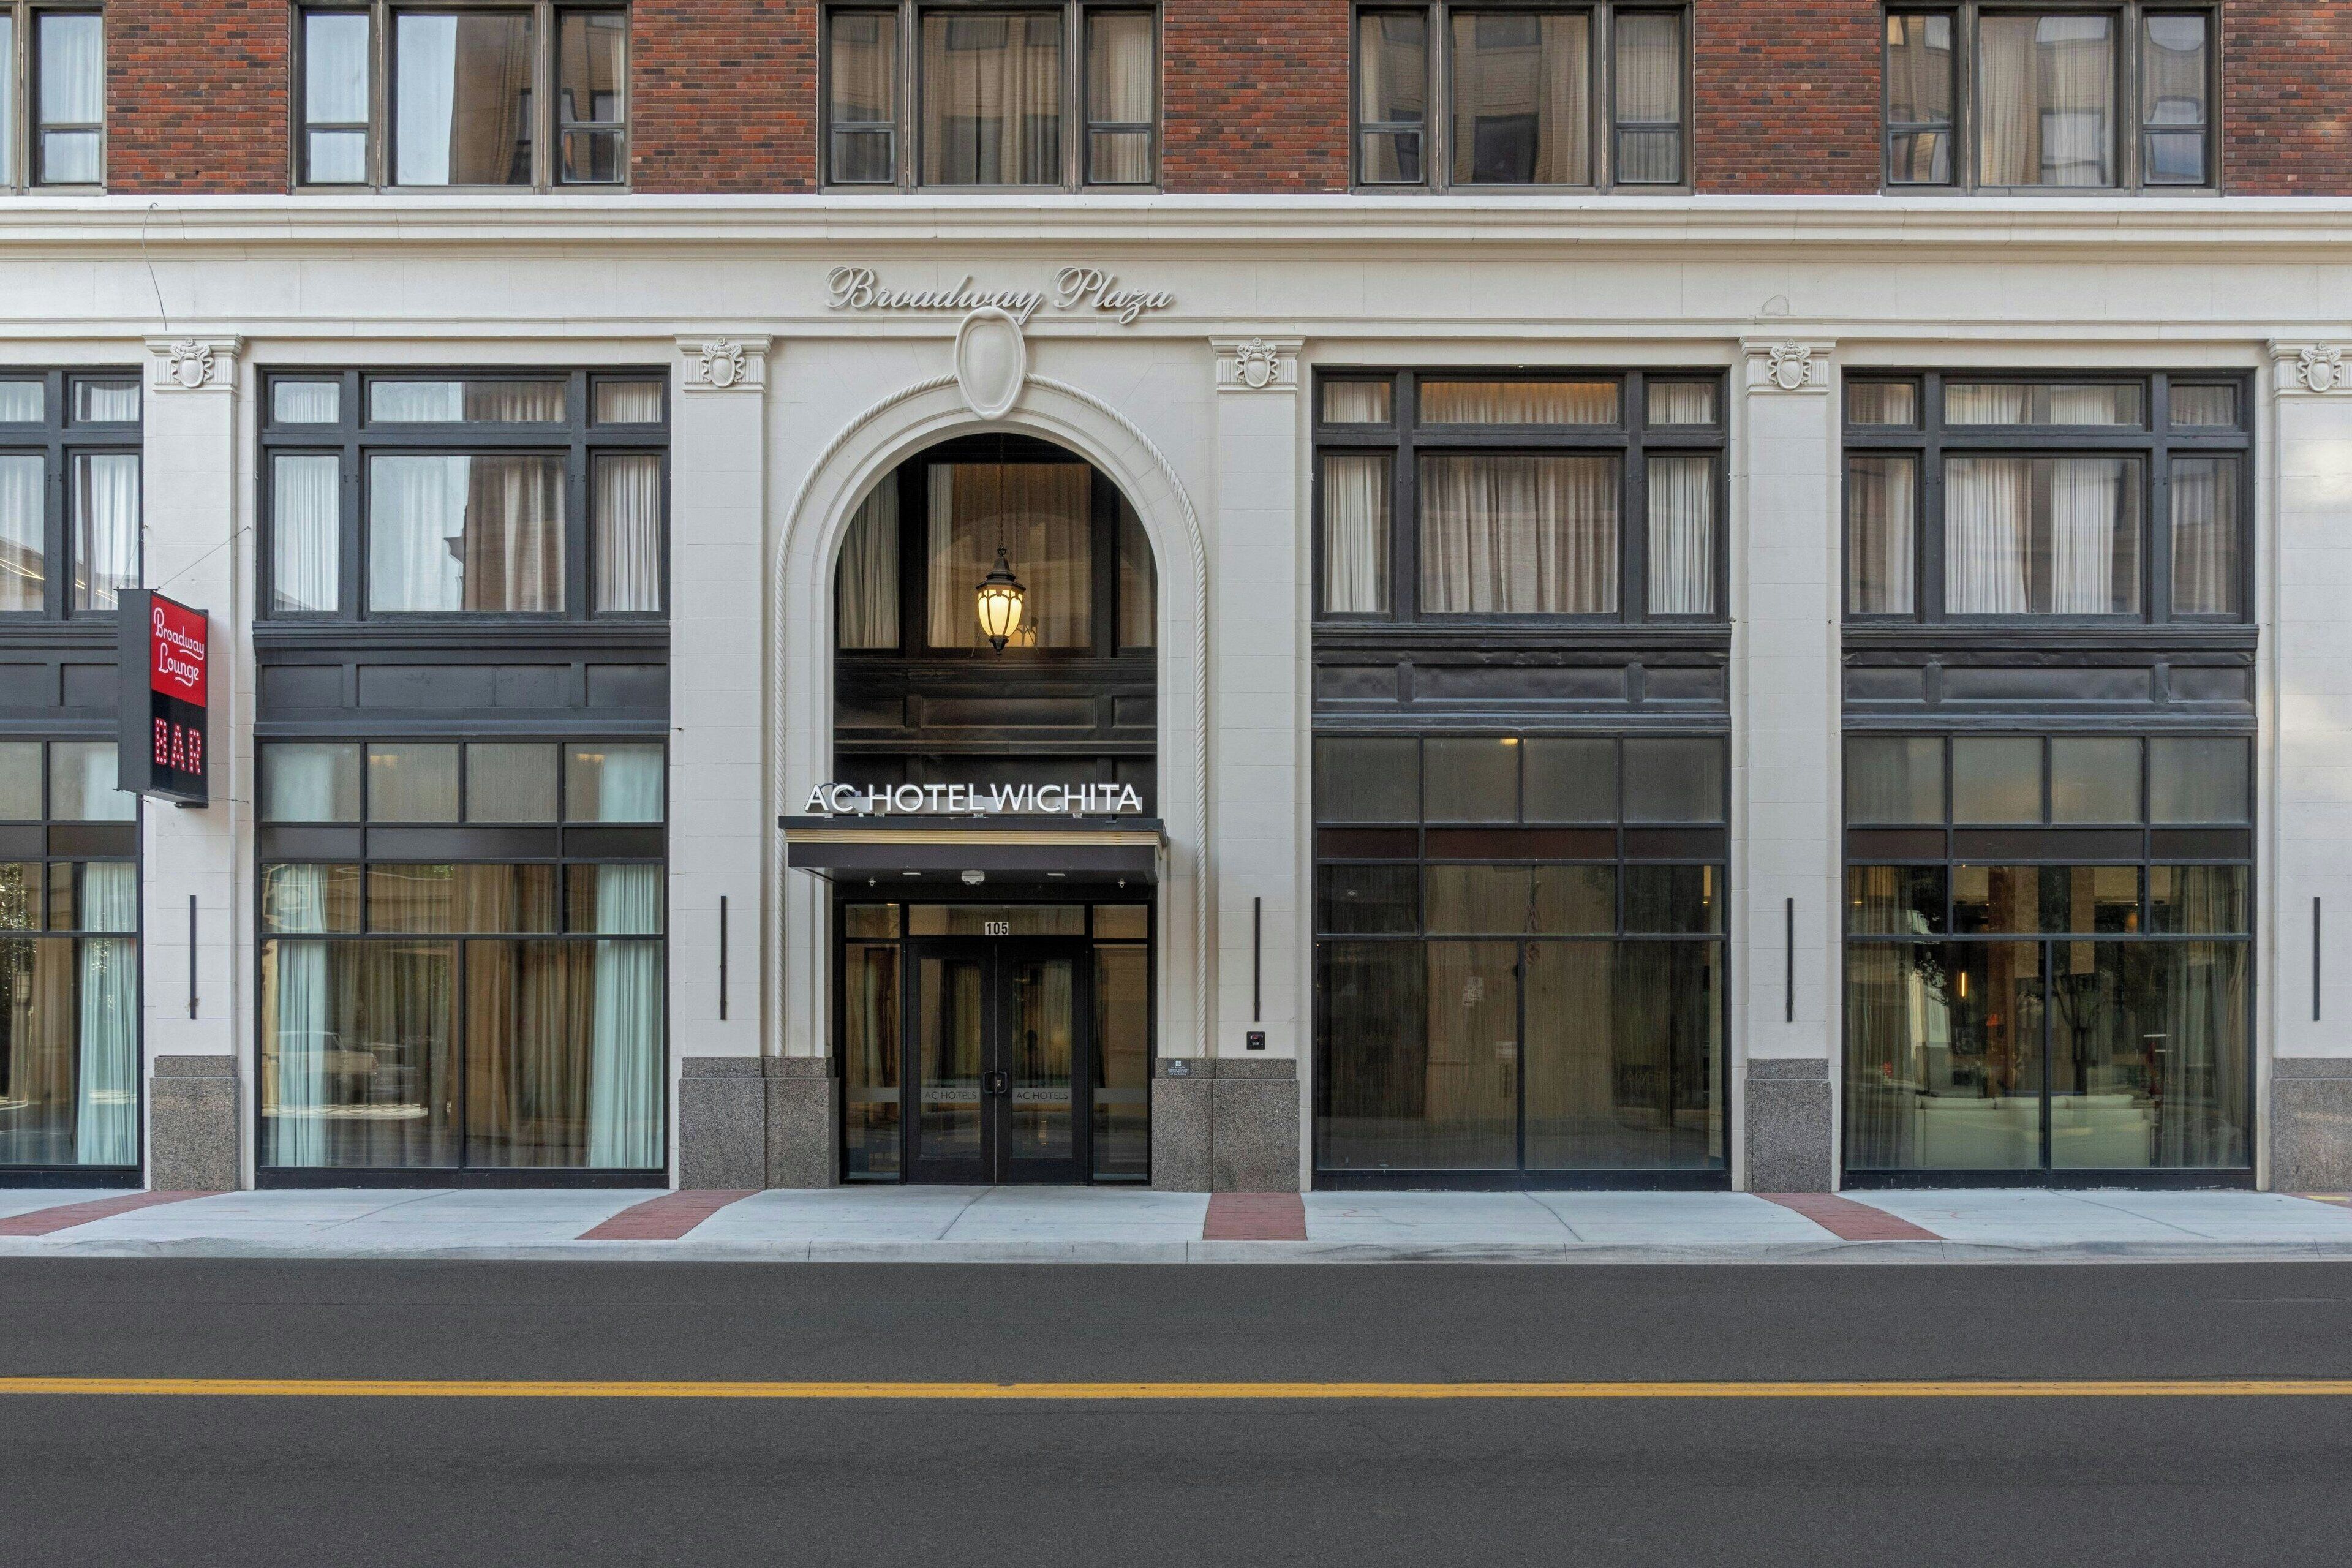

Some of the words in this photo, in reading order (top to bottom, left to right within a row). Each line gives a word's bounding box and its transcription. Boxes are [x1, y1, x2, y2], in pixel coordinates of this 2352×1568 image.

[825, 266, 1044, 325] Broadway
[1053, 266, 1174, 325] Plaza
[154, 606, 205, 661] Broadway
[158, 642, 200, 687] Lounge
[154, 717, 202, 775] BAR
[804, 783, 856, 812] AC
[868, 783, 986, 812] HOTEL
[989, 783, 1142, 813] WICHITA
[986, 922, 1008, 935] 105
[925, 1091, 938, 1100] AC
[940, 1091, 977, 1100] HOTELS
[1016, 1091, 1031, 1100] AC
[1033, 1091, 1069, 1100] HOTELS
